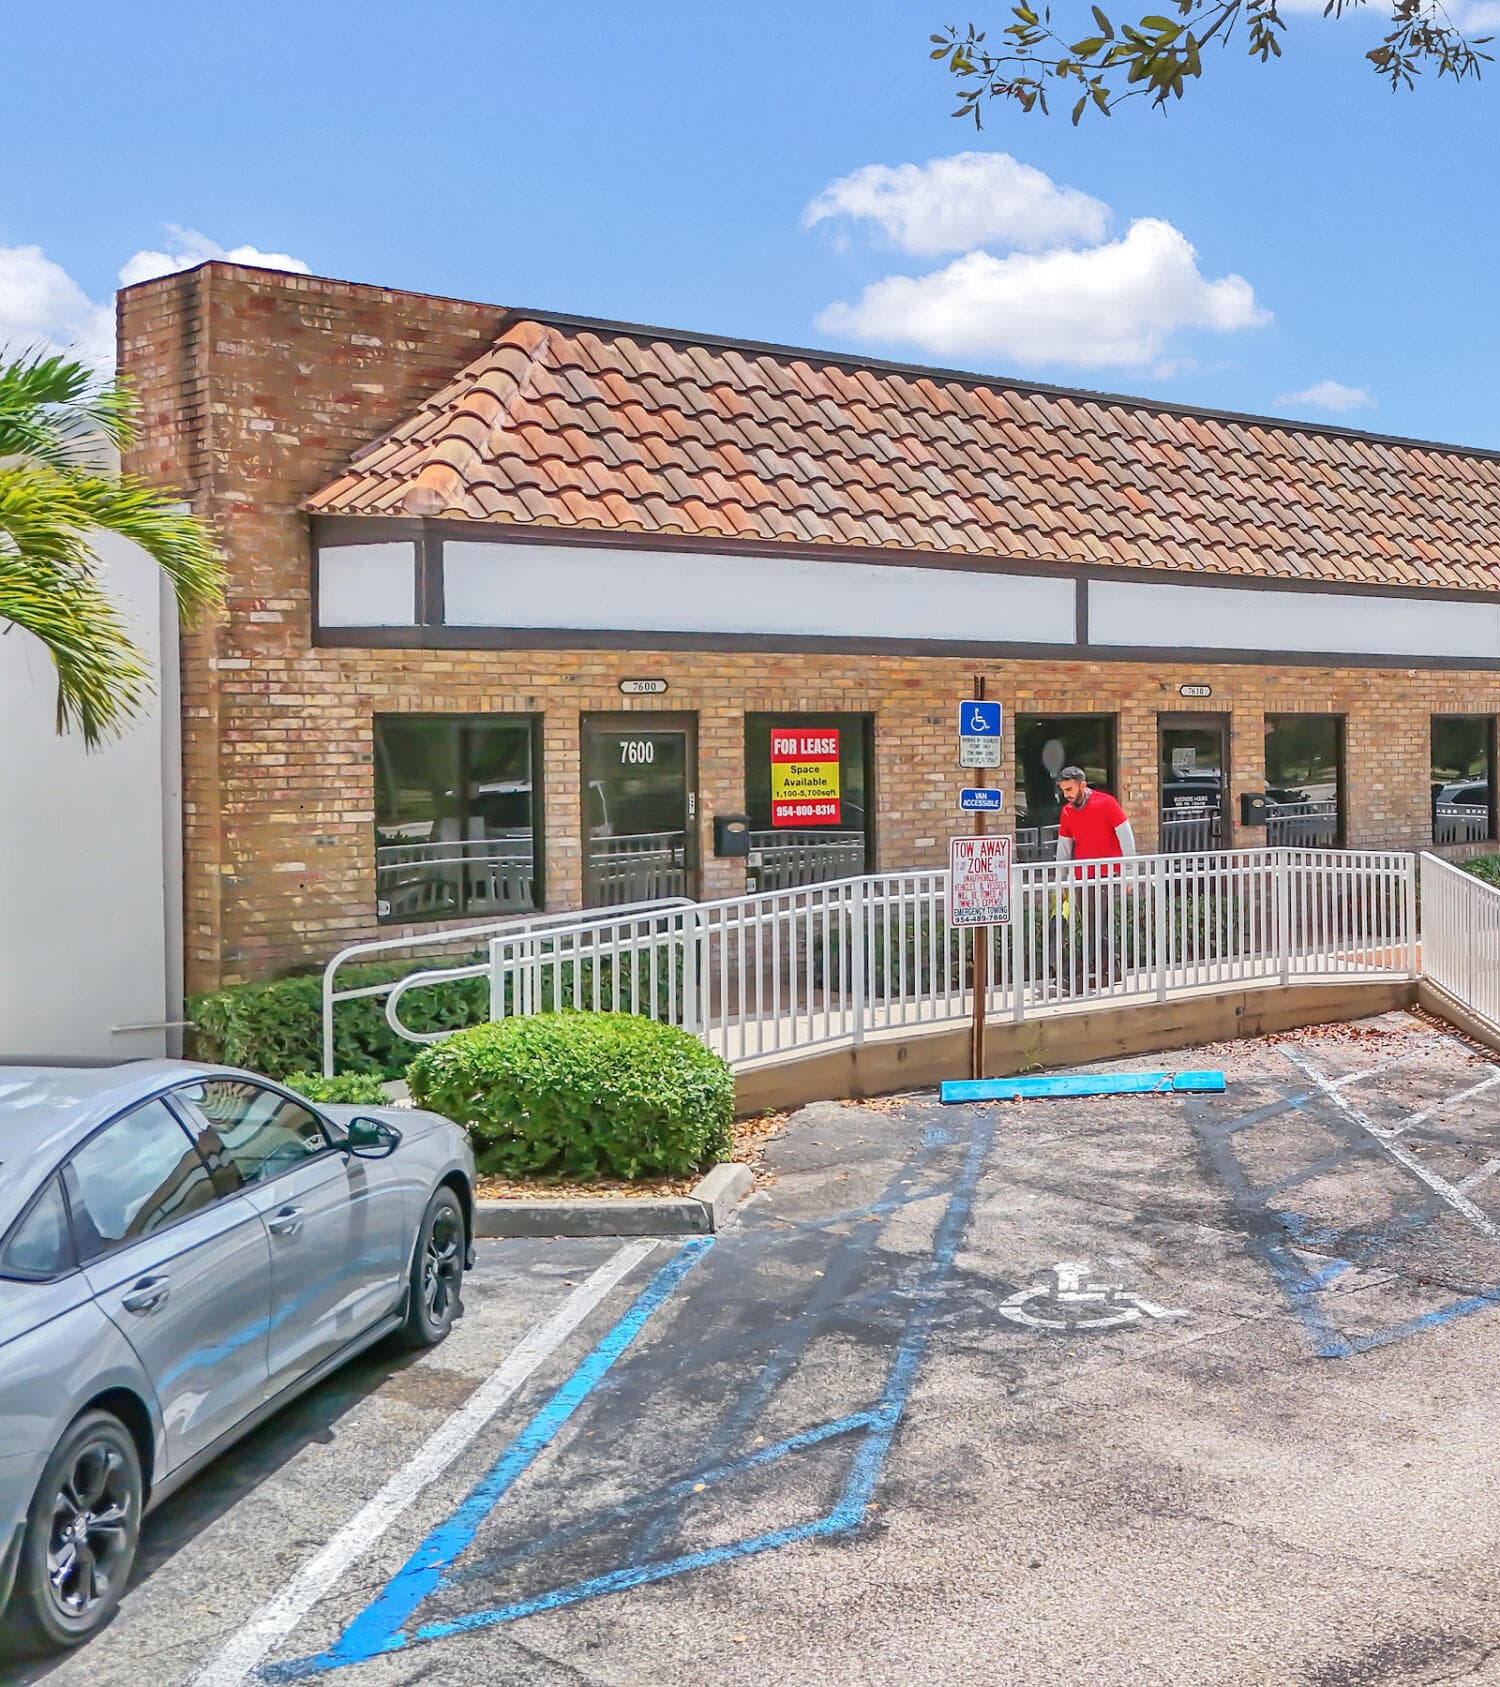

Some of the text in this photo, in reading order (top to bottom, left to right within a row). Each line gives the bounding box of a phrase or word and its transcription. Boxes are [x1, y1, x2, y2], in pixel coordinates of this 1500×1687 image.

[633, 682, 657, 691] 7600
[774, 738, 836, 755] FOR LEASE
[620, 741, 654, 764] 7600
[790, 765, 820, 775] Space
[783, 778, 827, 787] Available
[975, 792, 988, 800] VAN
[963, 799, 999, 807] ACCESSIBLE
[954, 841, 1007, 858] TOW AWAY
[968, 857, 993, 873] ZONE
[954, 906, 1008, 917] EMERGENCY TOWING
